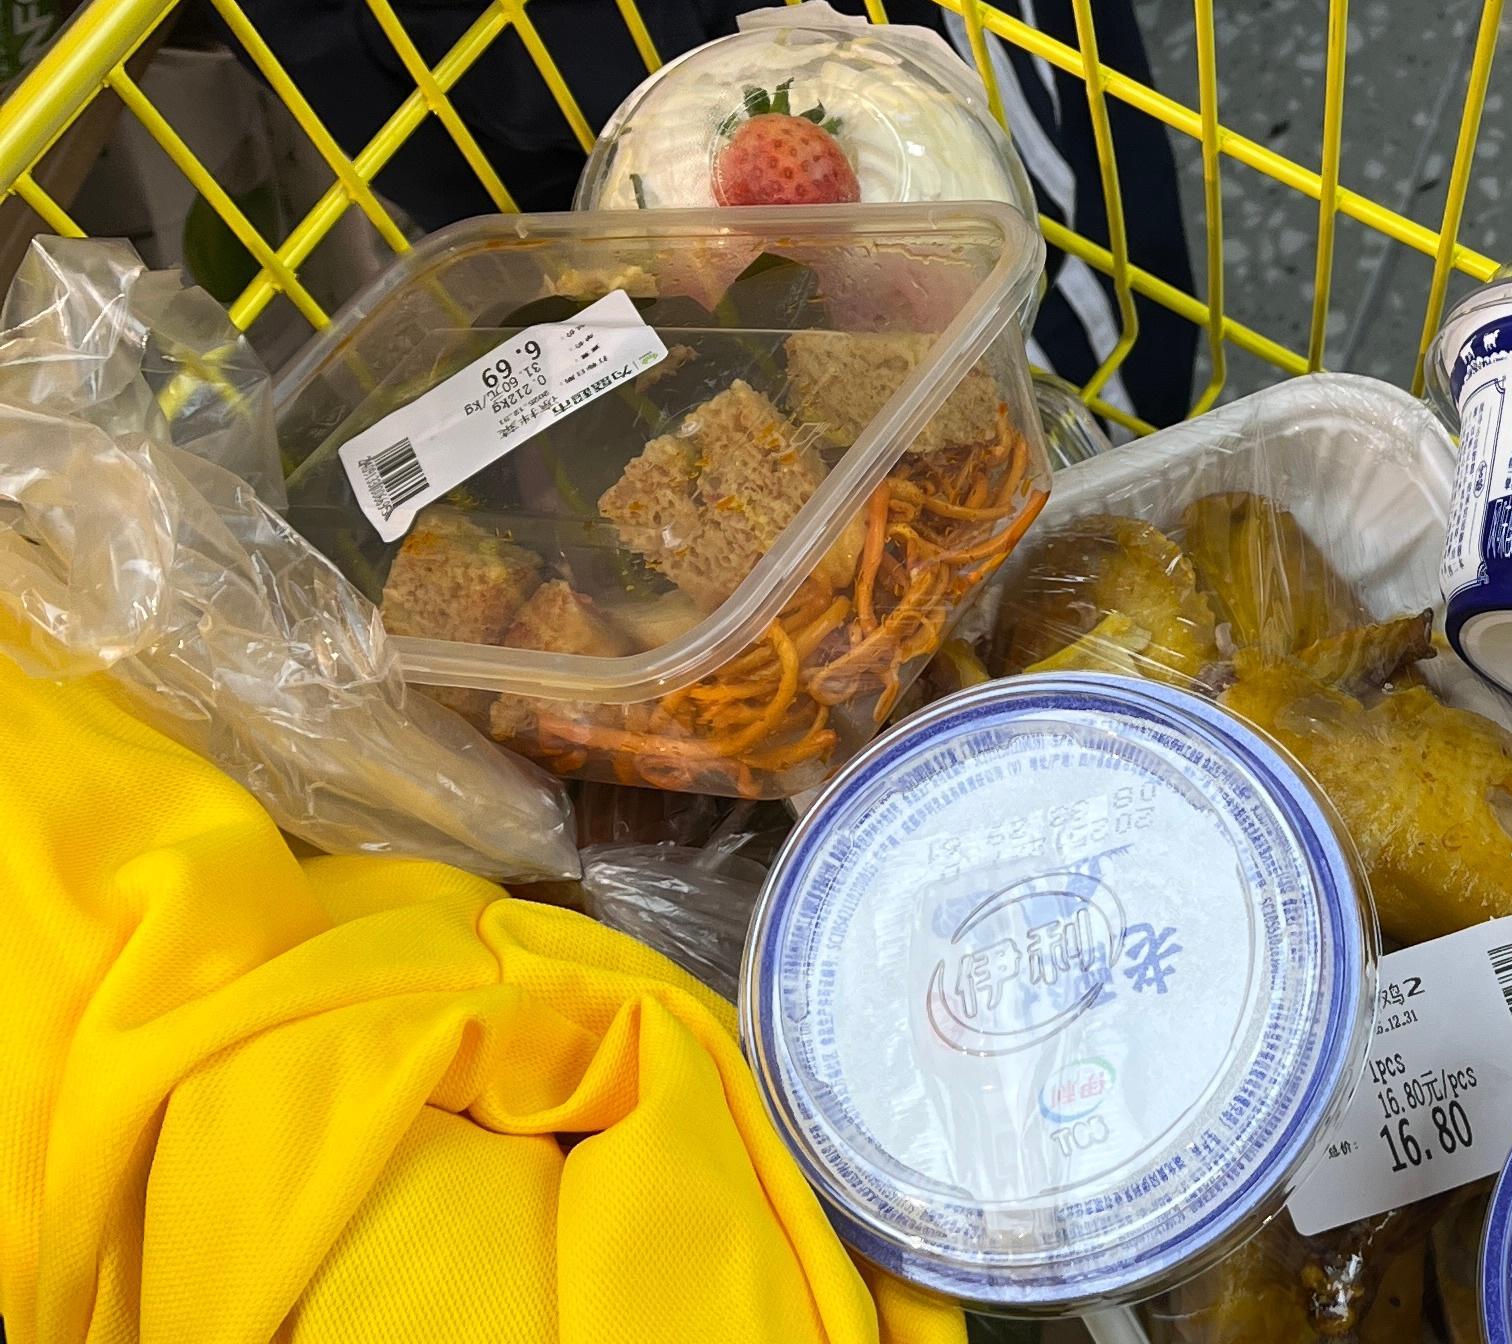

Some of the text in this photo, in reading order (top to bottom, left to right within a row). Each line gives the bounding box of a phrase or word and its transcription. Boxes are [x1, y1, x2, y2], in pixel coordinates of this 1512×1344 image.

[463, 361, 542, 417] 31.60元/kg
[482, 340, 543, 389] 6.69
[490, 374, 548, 414] 0.212kg
[499, 395, 561, 440] 凉拌菜
[955, 907, 1097, 1019] 伊利
[1369, 1052, 1406, 1084] 1pcs
[1377, 1065, 1478, 1119] 16.80元/pcs
[1379, 1099, 1474, 1173] 16.80
